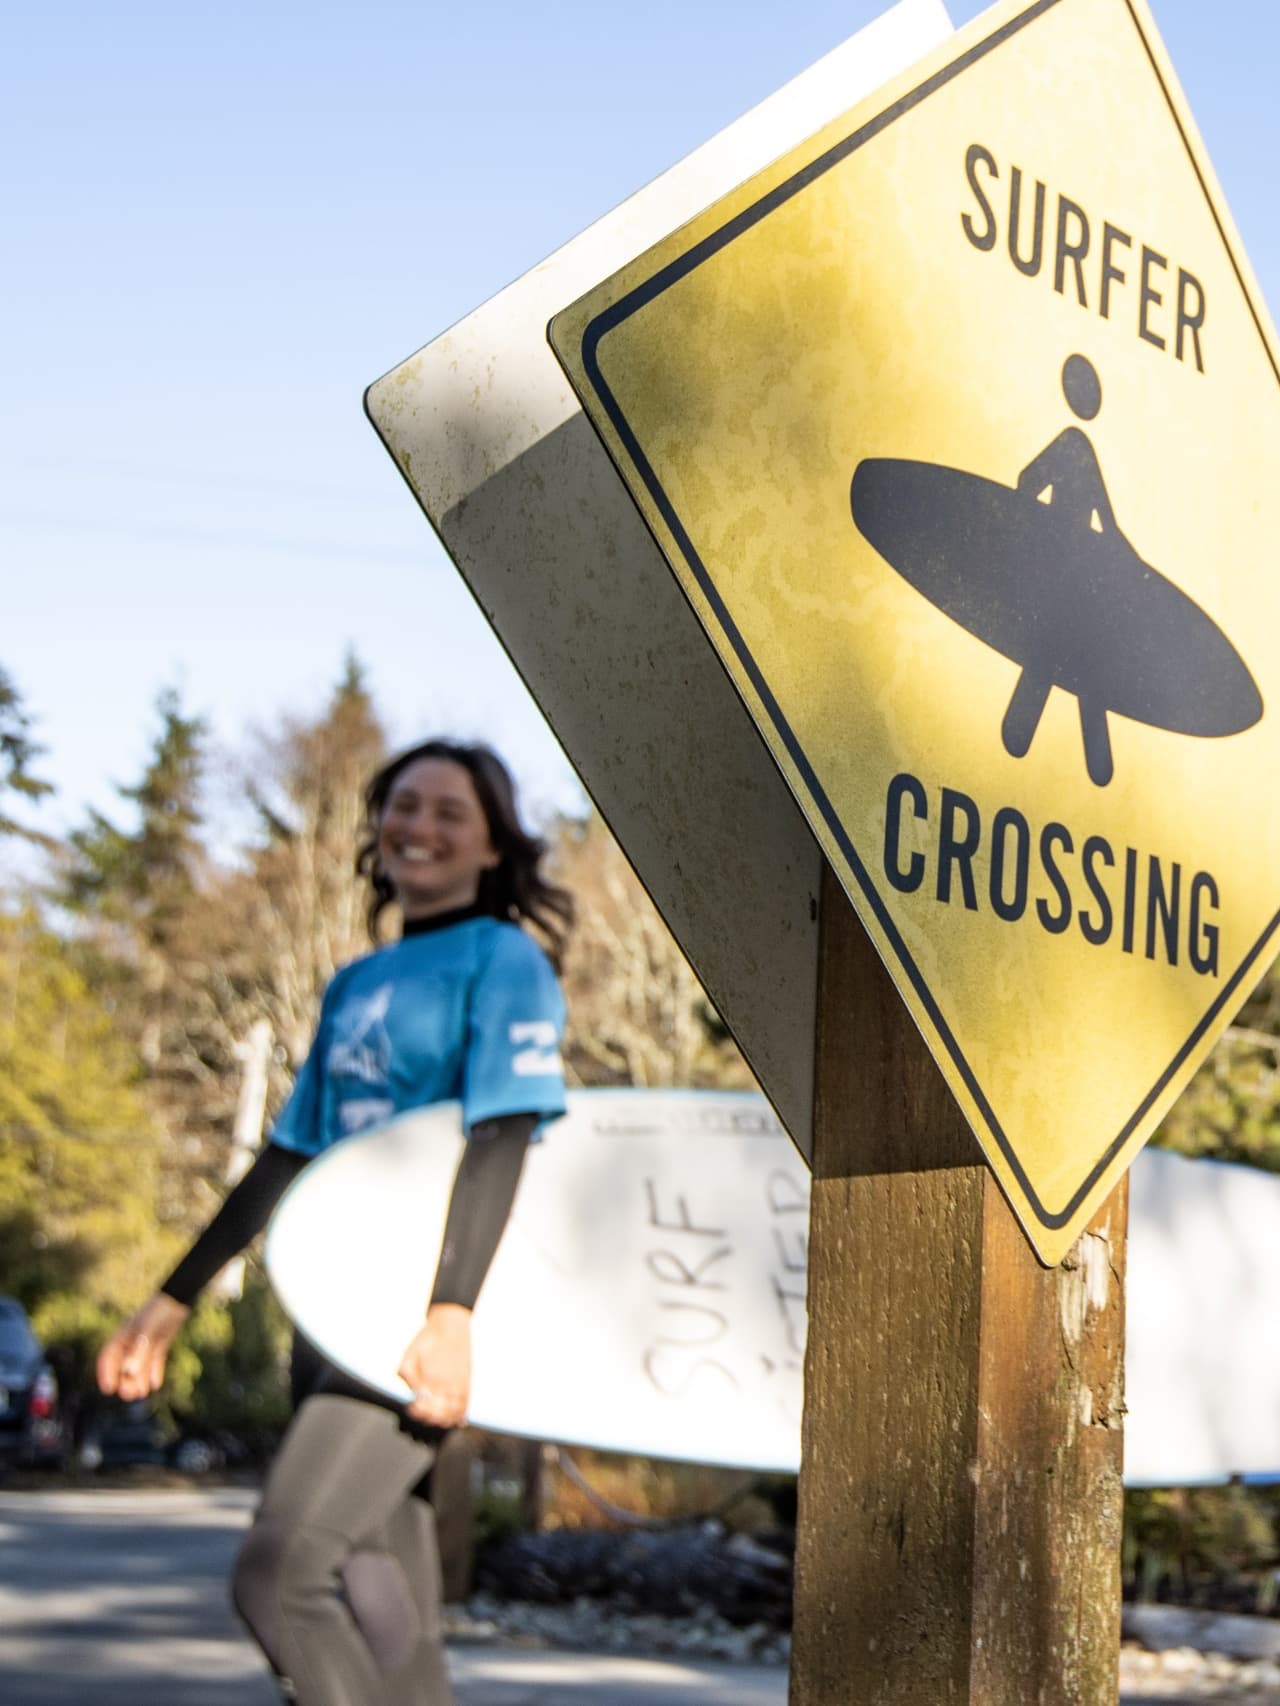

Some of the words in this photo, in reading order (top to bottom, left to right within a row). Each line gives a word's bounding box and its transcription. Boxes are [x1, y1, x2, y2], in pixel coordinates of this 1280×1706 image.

[960, 143, 1206, 375] SURFER
[883, 772, 1220, 978] CROSSING
[642, 1176, 739, 1397] SURF
